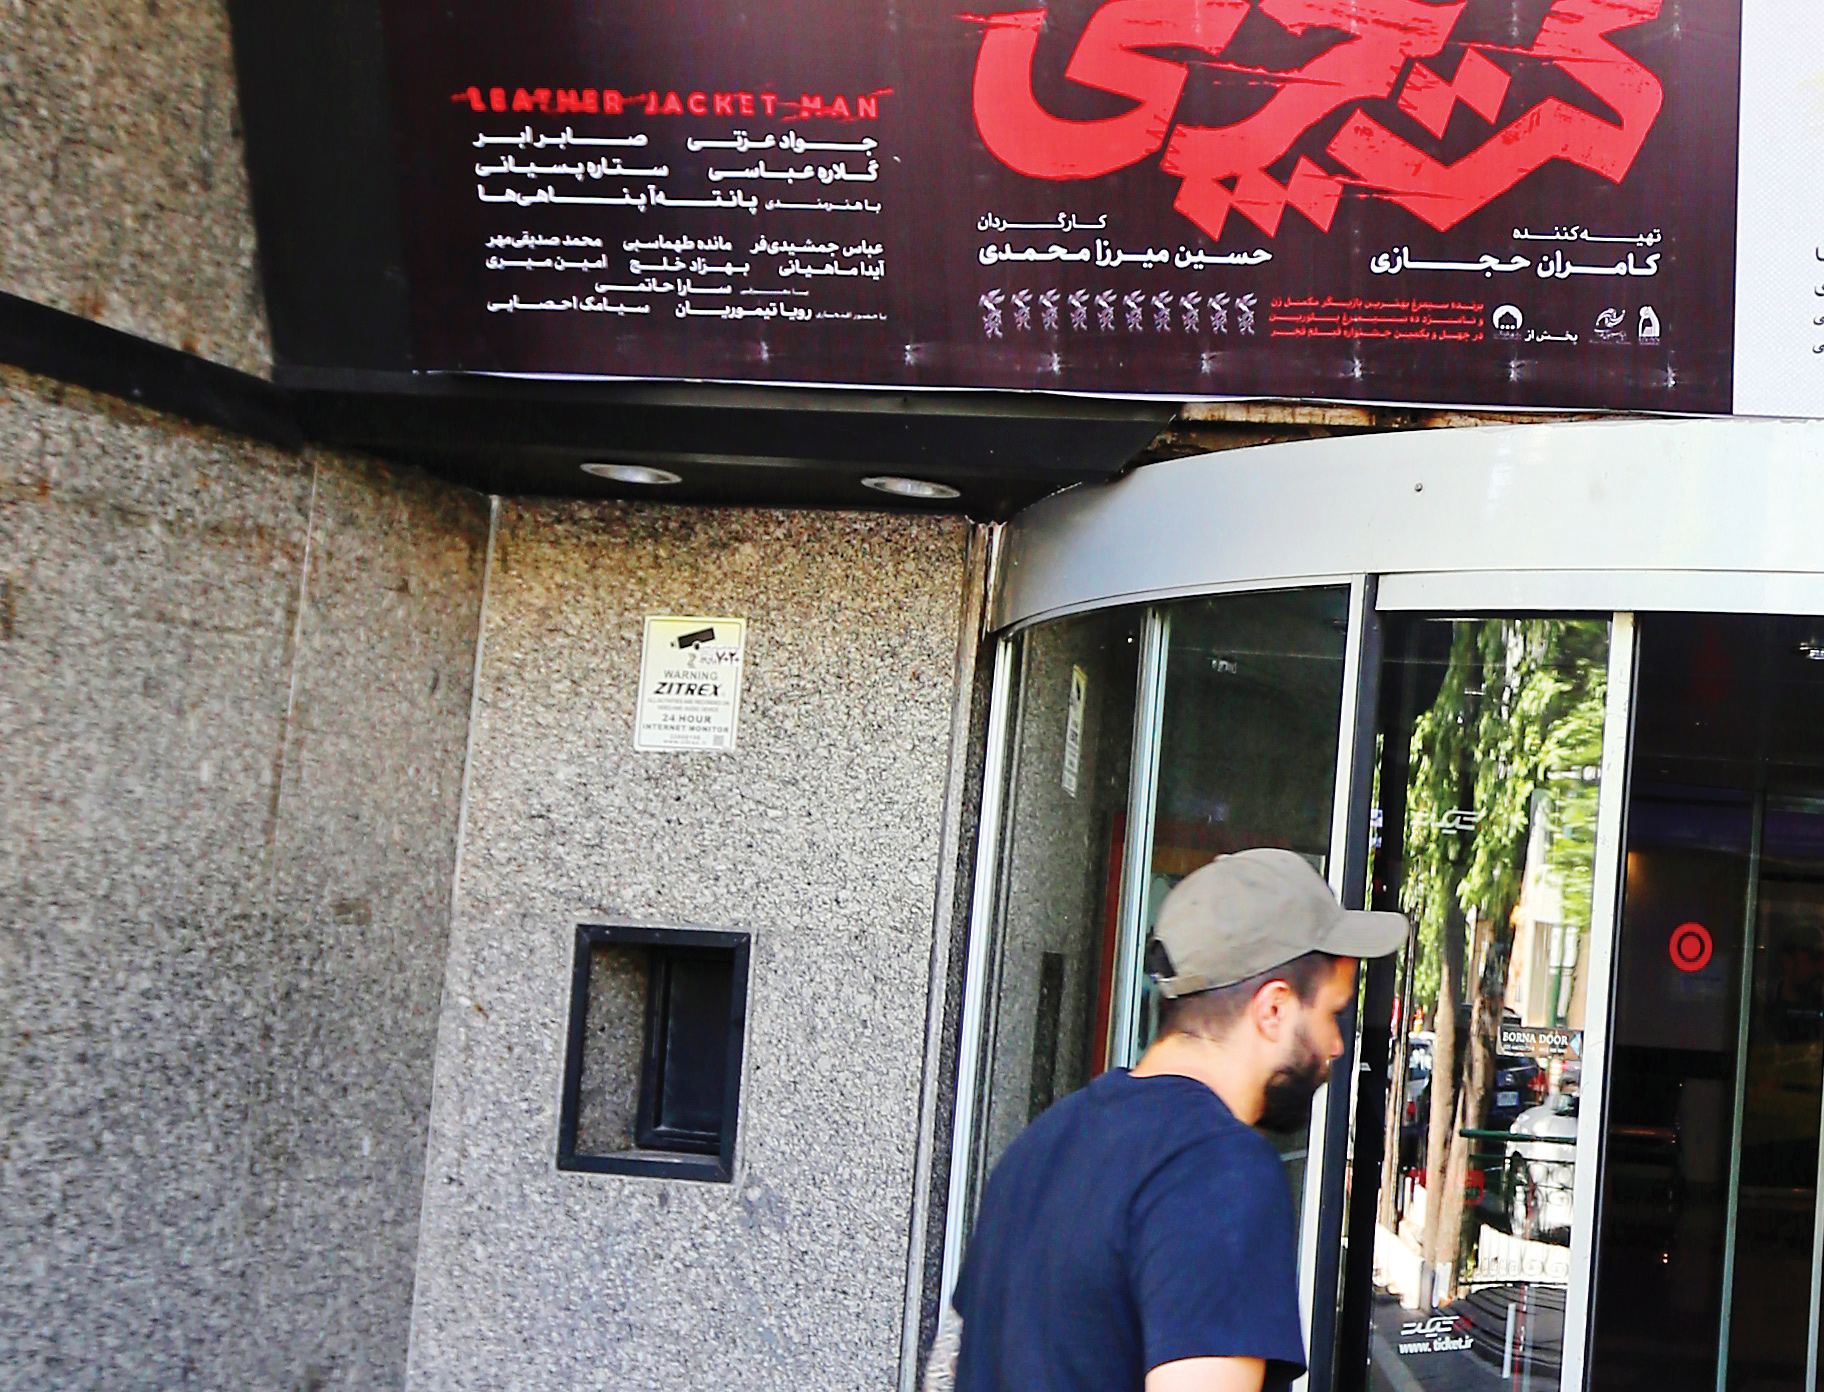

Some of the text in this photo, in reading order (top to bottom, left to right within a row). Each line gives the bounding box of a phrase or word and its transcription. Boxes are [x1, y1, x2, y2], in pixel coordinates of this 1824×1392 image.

[466, 86, 879, 121] LEATHER JACKET MAN
[472, 125, 649, 150] صابر ابر
[686, 128, 879, 157] جواد عزتی
[475, 154, 669, 182] ستاره پسیانی
[708, 159, 880, 185] گلاره عباسی
[764, 198, 864, 213] هنرمندی
[865, 198, 882, 215] با
[977, 212, 1107, 232] کارگردان
[562, 234, 603, 249] محمد
[622, 234, 695, 254] طهماسبی
[842, 239, 884, 258] عباس
[485, 253, 609, 272] امین میری
[978, 239, 1273, 270] حسین میرزا محمدی
[1370, 246, 1661, 279] کامران حجازی
[629, 256, 750, 277] بهزاد خلج
[778, 259, 885, 281] آیدا ماهیانی
[594, 277, 675, 294] حاتمی
[677, 278, 732, 297] سارا
[487, 294, 651, 316] سیامک احصایی
[675, 300, 778, 321] تیموریان
[780, 302, 813, 321] رویا
[1524, 328, 1535, 342] از
[1535, 330, 1579, 345] پخش
[664, 669, 718, 681] WARNING
[653, 681, 722, 697] ZITREX
[679, 714, 711, 723] HOUR
[1502, 1031, 1569, 1046] BORNA DOOR
